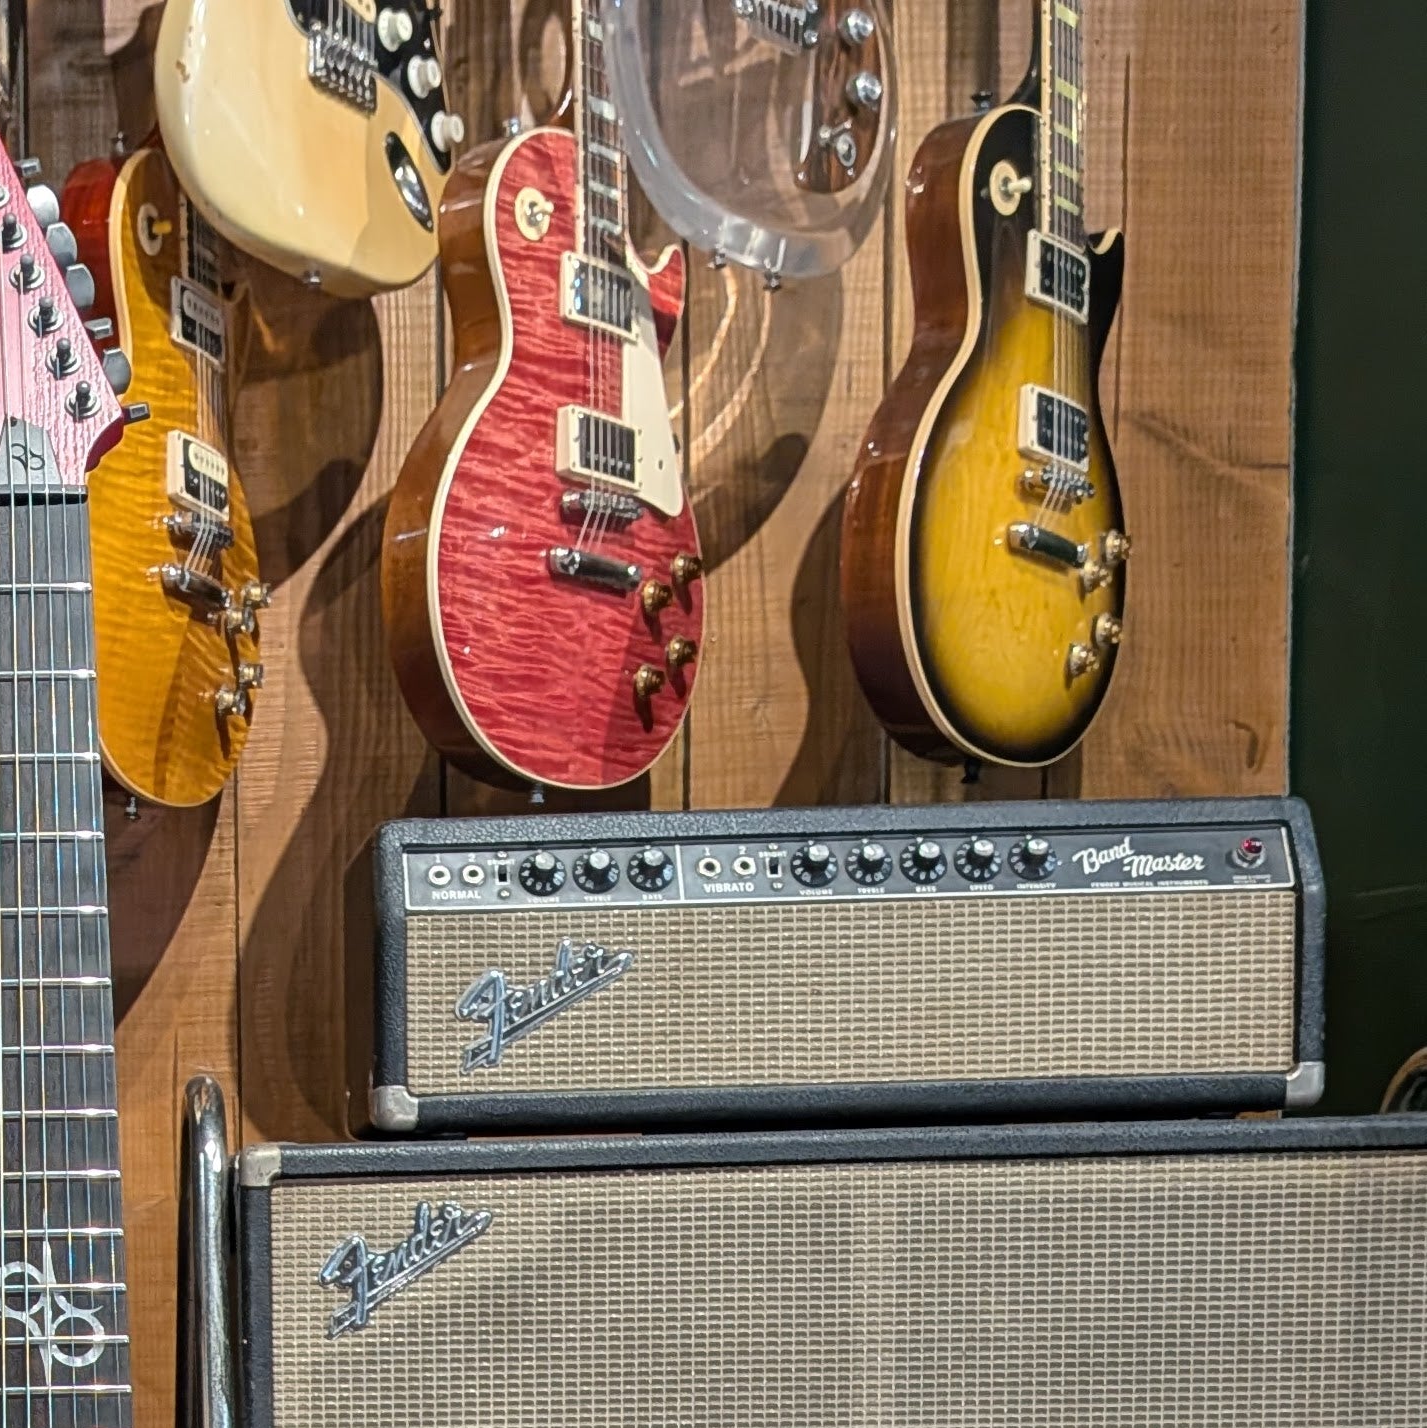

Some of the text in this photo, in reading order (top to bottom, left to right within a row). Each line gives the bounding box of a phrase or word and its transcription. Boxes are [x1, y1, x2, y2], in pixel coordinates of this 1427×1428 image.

[1072, 836, 1135, 875] Band
[432, 890, 481, 900] NORMAL
[703, 882, 754, 893] VIBRATO
[455, 936, 634, 1074] Fender
[319, 1201, 493, 1340] Fender
